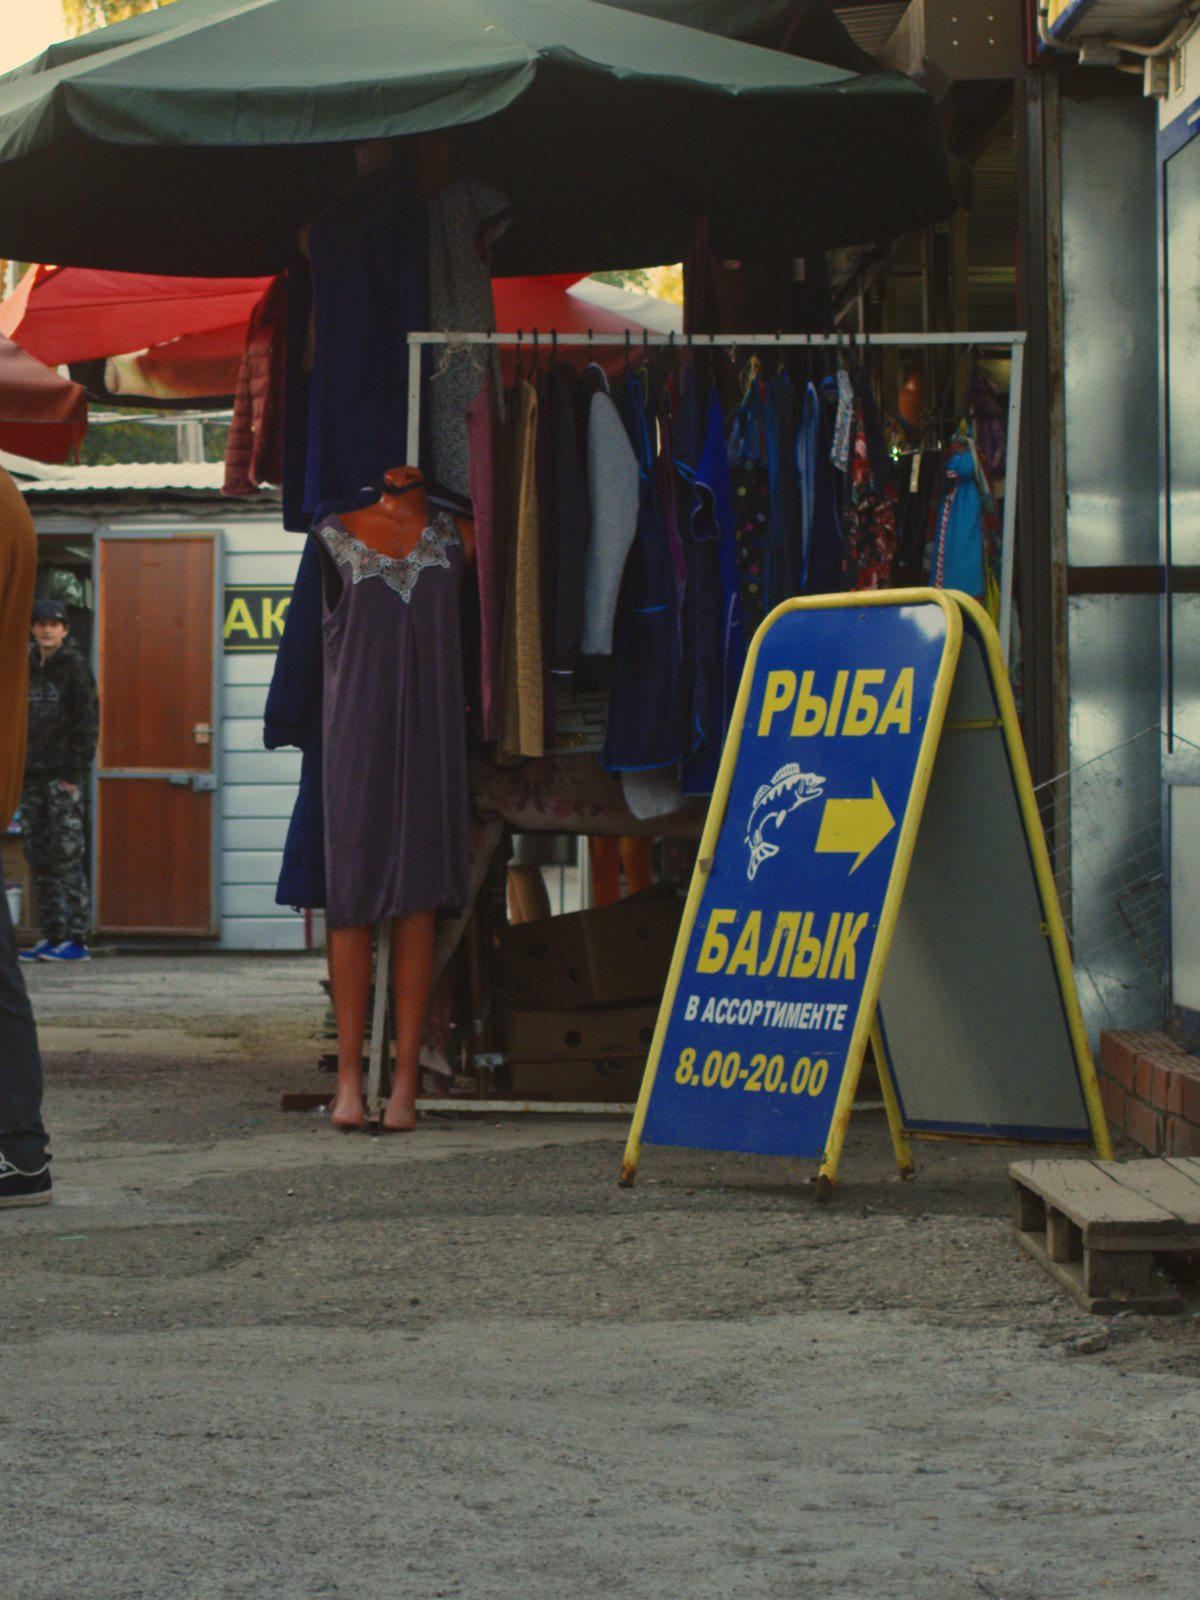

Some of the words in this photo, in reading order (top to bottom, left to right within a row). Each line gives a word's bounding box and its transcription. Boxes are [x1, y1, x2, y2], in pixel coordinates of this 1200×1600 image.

[757, 667, 915, 738] РЫБА
[696, 909, 870, 980] БАЛЫК
[684, 995, 700, 1021] В
[700, 997, 849, 1032] АССОРТИМЕНТЕ
[675, 1047, 829, 1097] 8.00-20.00
